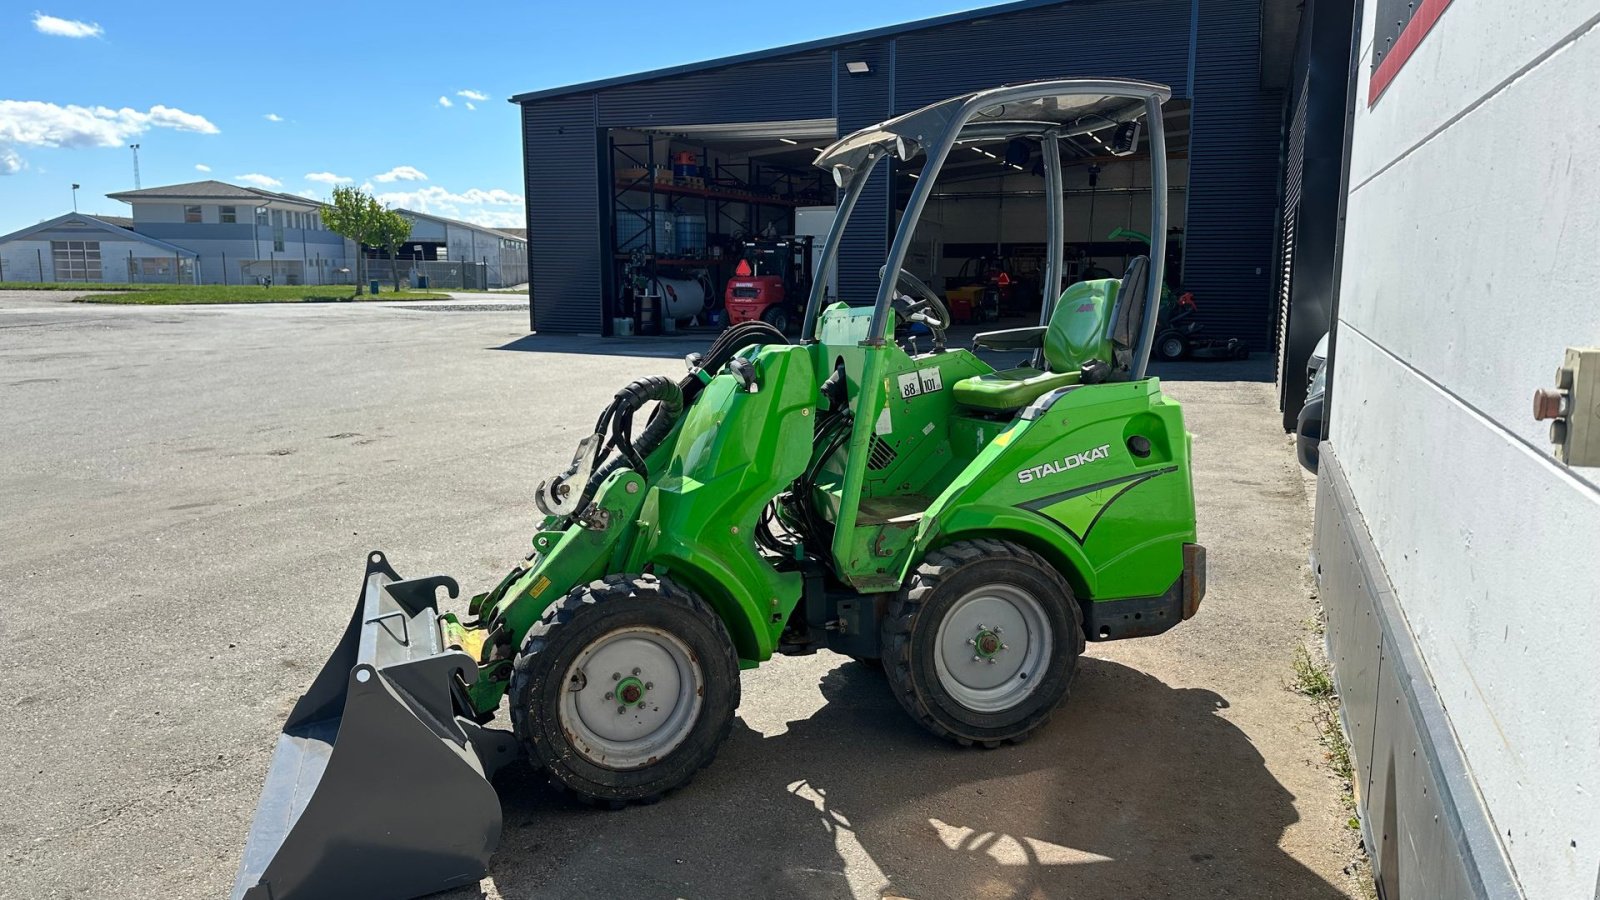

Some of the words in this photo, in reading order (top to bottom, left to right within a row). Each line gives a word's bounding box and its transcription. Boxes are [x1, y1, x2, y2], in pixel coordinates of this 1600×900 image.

[904, 382, 916, 396] 88
[923, 378, 936, 391] 101
[1018, 444, 1110, 484] STALDKAT
